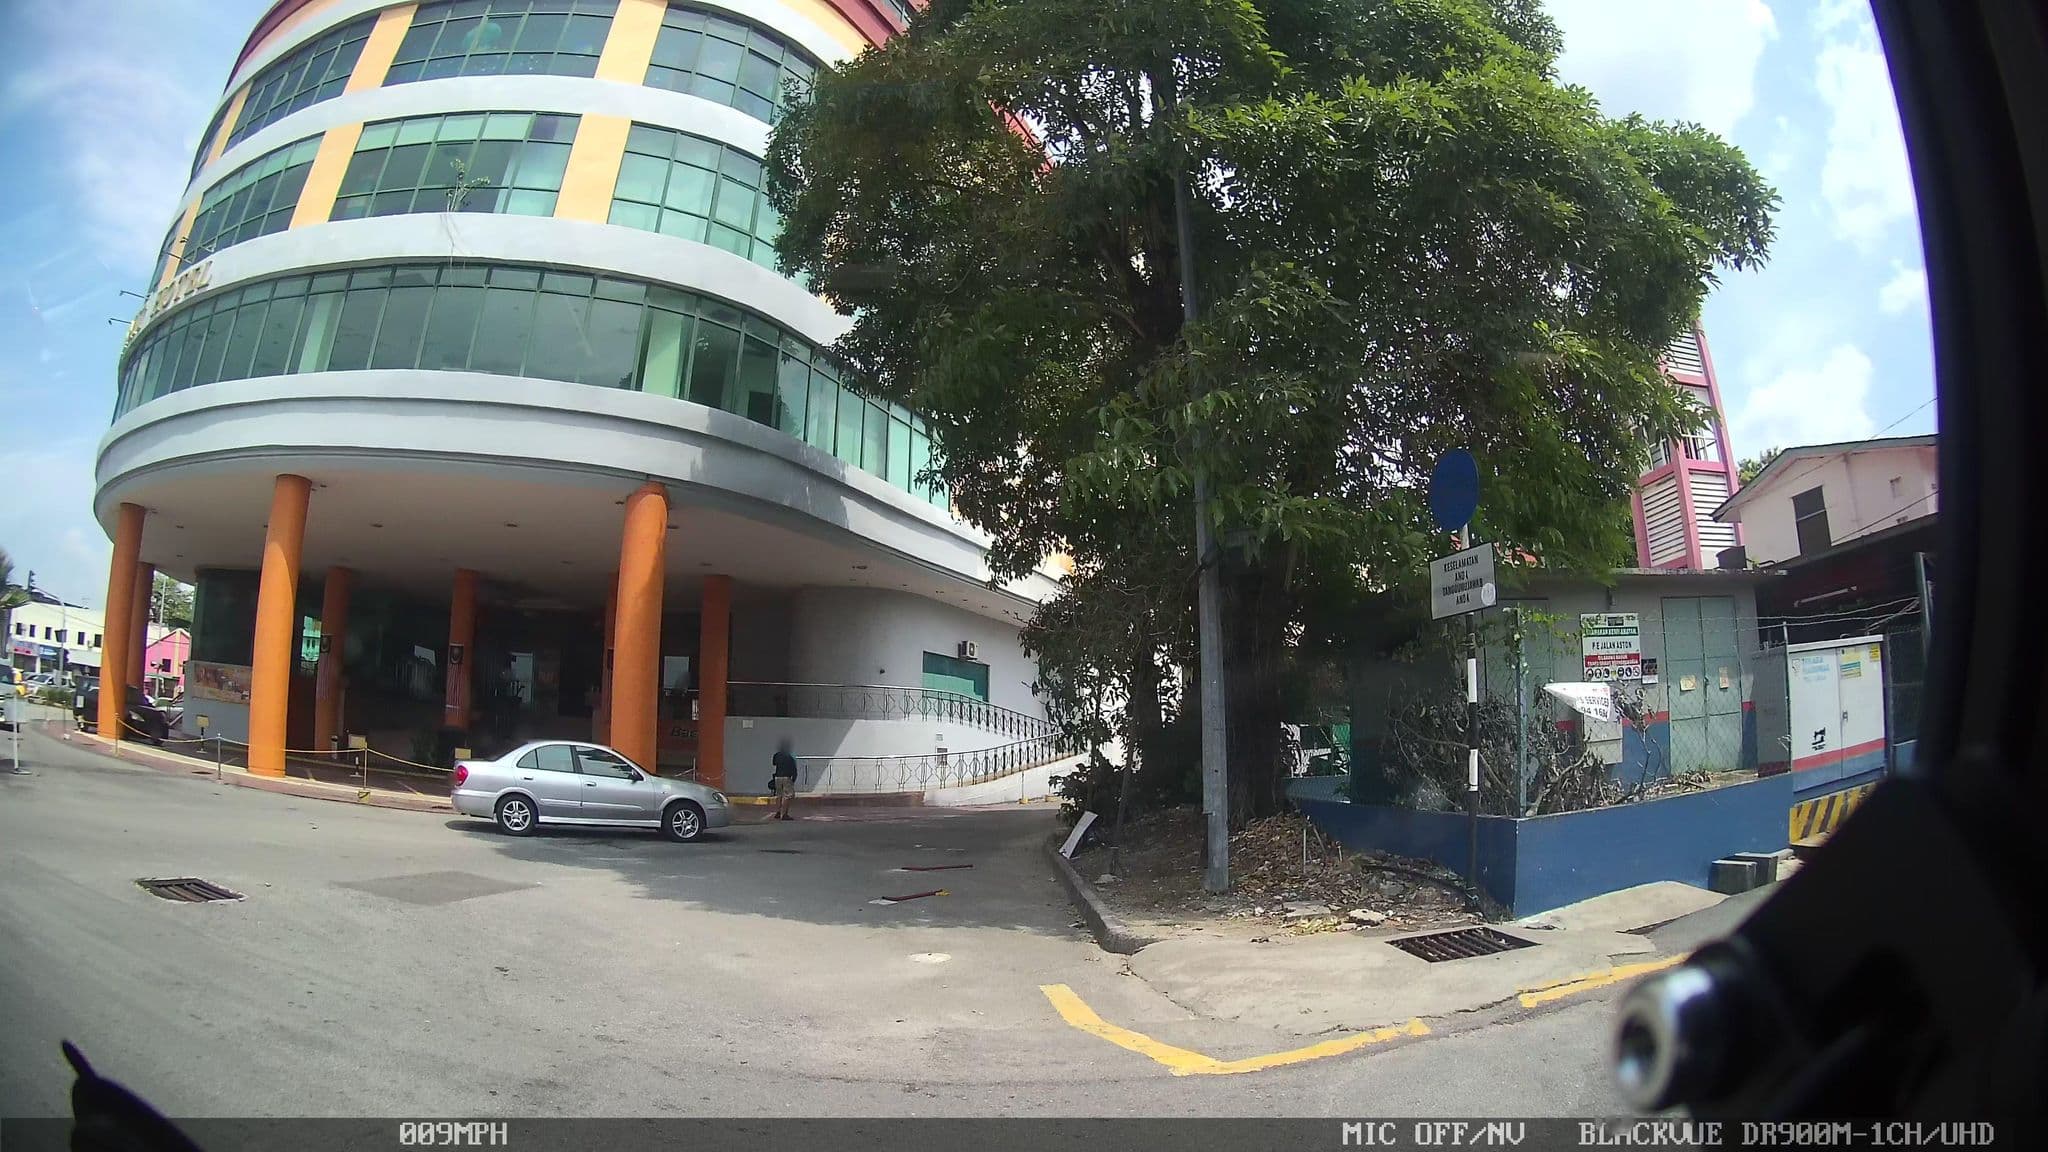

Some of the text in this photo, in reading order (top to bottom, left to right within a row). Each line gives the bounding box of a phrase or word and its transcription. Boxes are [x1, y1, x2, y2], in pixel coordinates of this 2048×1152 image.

[1444, 554, 1478, 572] KESELAMATAN
[1455, 570, 1468, 581] ANDA
[1456, 592, 1470, 605] ANDA
[1601, 641, 1615, 650] JALAN
[1616, 640, 1632, 649] ASTON
